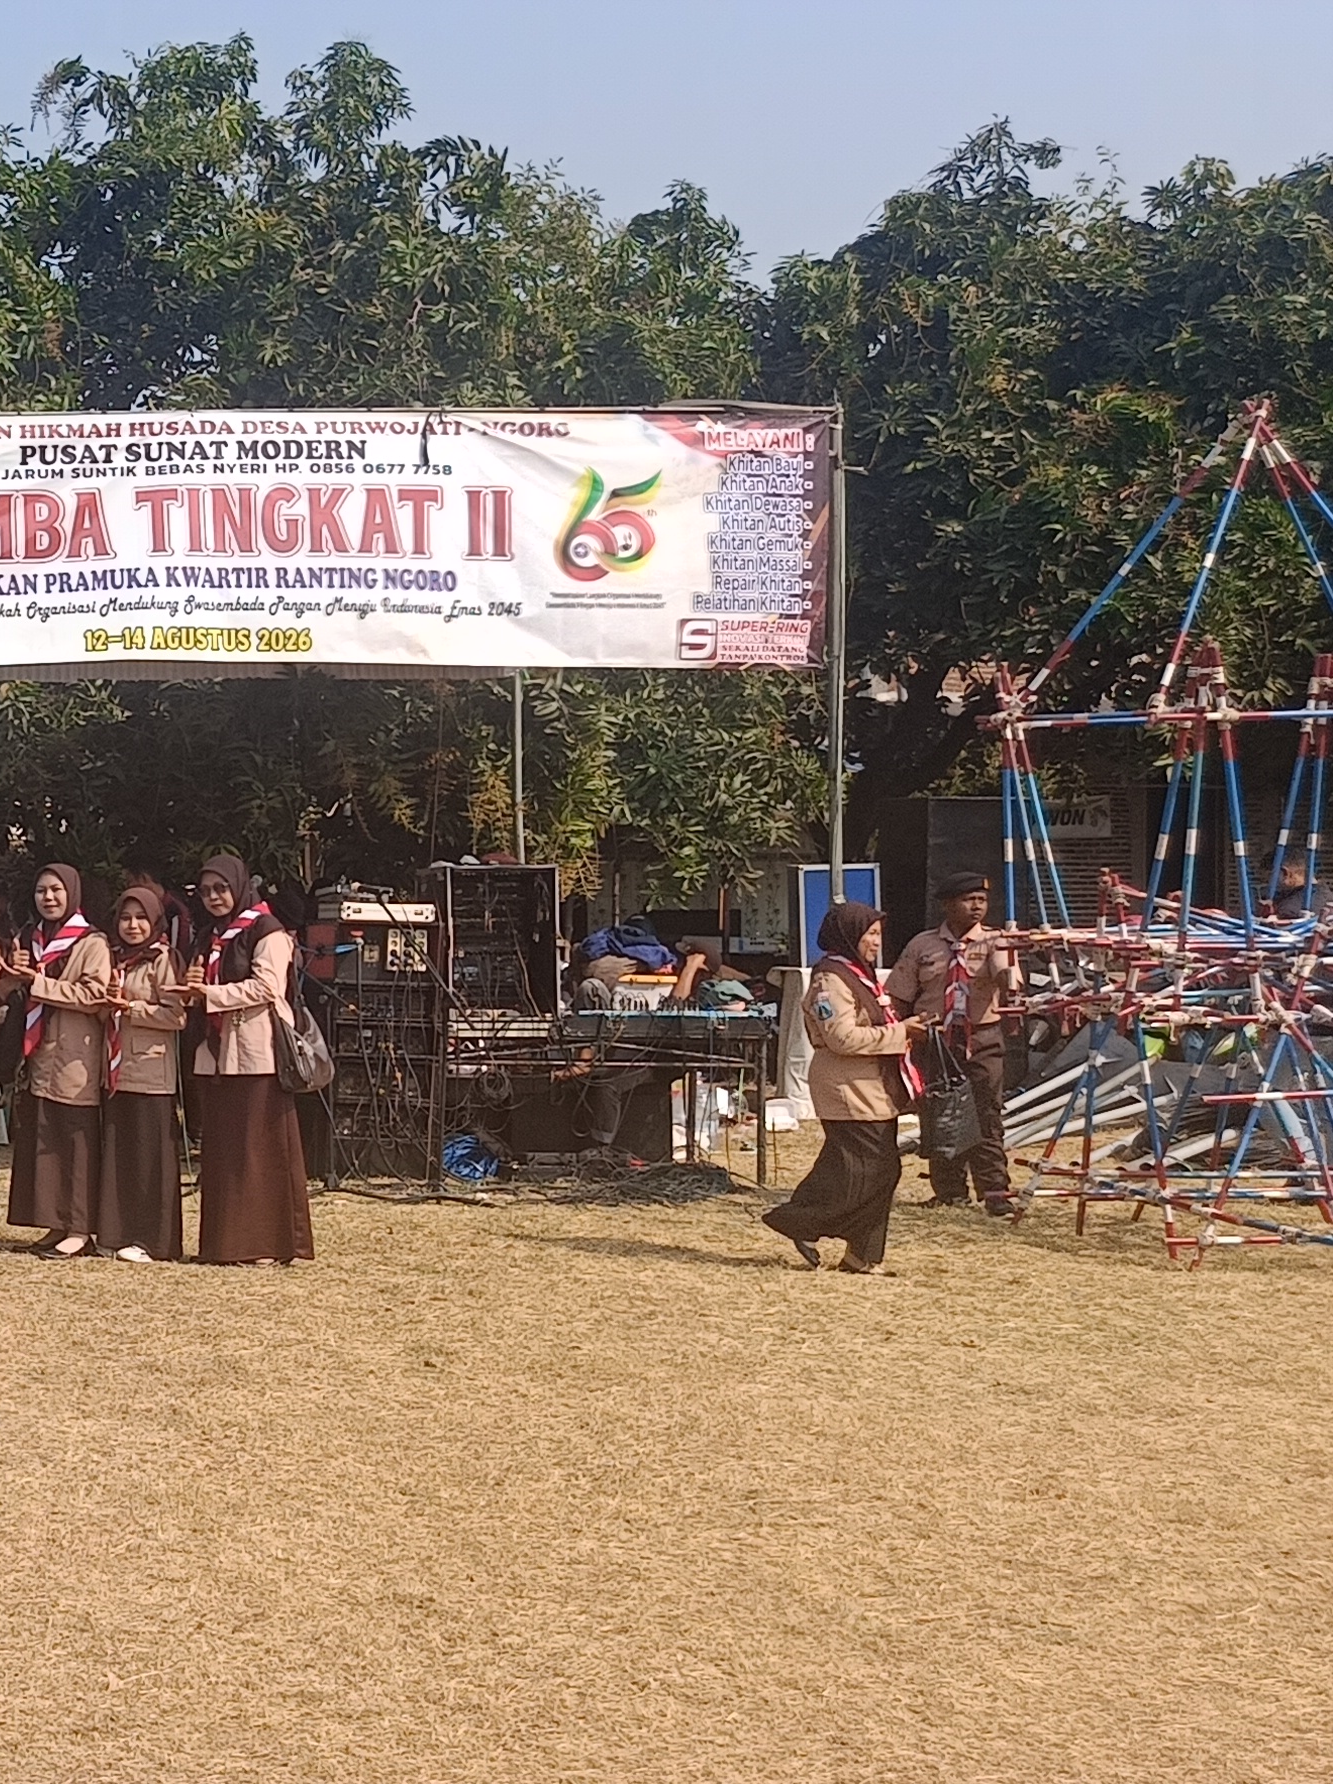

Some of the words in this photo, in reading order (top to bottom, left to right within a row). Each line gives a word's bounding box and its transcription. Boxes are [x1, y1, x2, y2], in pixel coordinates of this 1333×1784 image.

[19, 422, 122, 439] HIKMAH
[129, 420, 233, 437] HUSADA
[241, 420, 308, 435] DESA
[19, 443, 117, 466] PUSAT
[124, 439, 229, 463] SUNAT
[236, 439, 367, 460] MODERN
[1, 468, 64, 480] JARUM
[71, 466, 137, 479] SUNTIK
[145, 462, 205, 477] BEBAS
[213, 463, 268, 475] NYERI
[309, 463, 355, 475] 0856
[362, 463, 406, 475] 0677
[729, 455, 771, 472] Khitan
[720, 475, 765, 492] Khitan
[769, 476, 802, 492] Anak
[705, 495, 750, 511] Khitan
[754, 496, 802, 511] Dewasa
[132, 483, 444, 562] TINGKAT
[460, 484, 515, 562] II
[721, 515, 765, 531] Khitan
[769, 515, 802, 531] Autis
[710, 535, 752, 551] Khitan
[757, 536, 802, 551] Gemuk
[712, 555, 755, 571] Khitan
[759, 555, 801, 572] Massal
[44, 567, 160, 593] PRAMUKA
[165, 566, 269, 589] KWARTIR
[275, 567, 378, 590] RANTING
[382, 569, 458, 591] NGORO
[715, 575, 756, 595] Repair
[760, 576, 801, 591] Khitan
[26, 601, 96, 623] Organisasi
[100, 595, 179, 621] Mendukung
[183, 594, 265, 615] Swasembada
[269, 595, 322, 619] Pangan
[325, 595, 377, 620] Menuju
[444, 599, 483, 623] Emas
[487, 600, 523, 616] 2045
[695, 594, 756, 611] Pelatihan
[760, 596, 801, 612] Khitan
[720, 620, 809, 634] SUPER-RING
[150, 626, 250, 651] AGUSTUS
[256, 627, 313, 652] 2026
